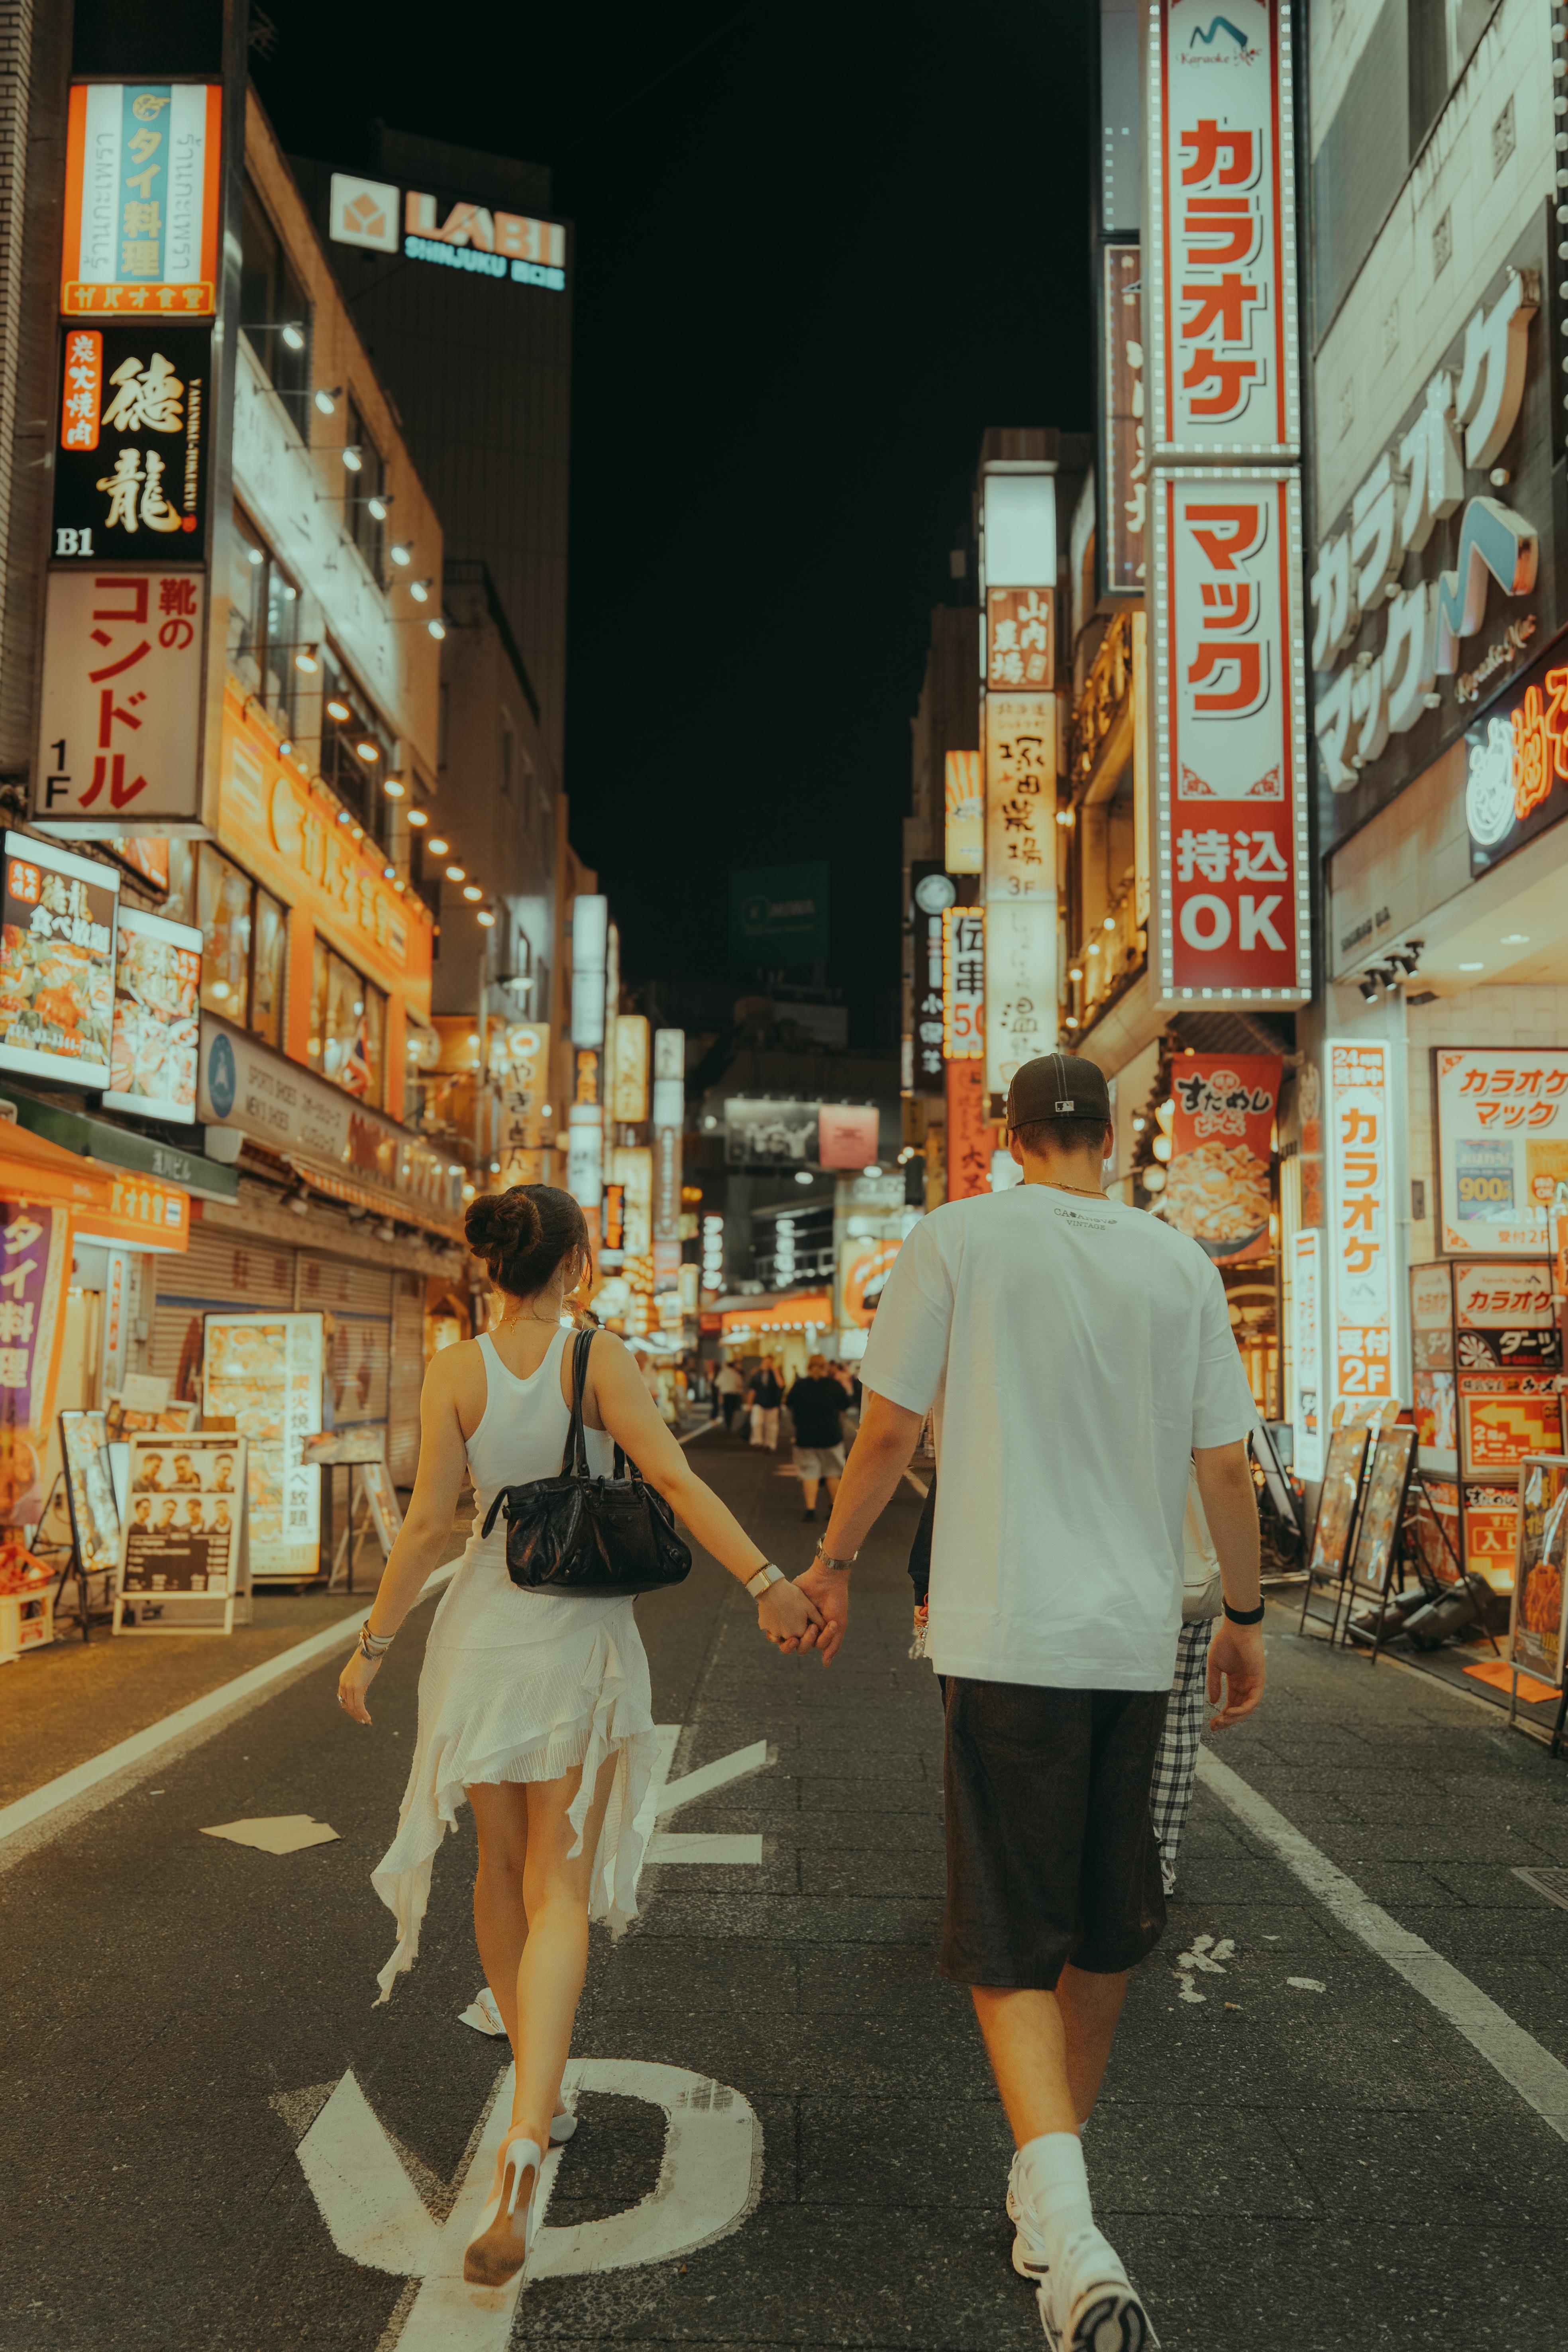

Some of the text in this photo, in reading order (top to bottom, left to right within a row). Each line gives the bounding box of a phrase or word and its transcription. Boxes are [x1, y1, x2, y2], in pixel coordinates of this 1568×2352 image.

[121, 128, 163, 276] タイ料理
[405, 190, 565, 268] LABI
[404, 236, 507, 278] SHINJUKU
[1178, 119, 1262, 418] カラオケ
[75, 287, 204, 309] ガパオ食堂
[66, 334, 96, 446] 炭火焼肉
[1311, 272, 1529, 671] カラオケ
[55, 527, 94, 556] B1
[158, 578, 197, 650] 靴の
[1185, 504, 1262, 711] マック
[77, 577, 152, 809] コンドル
[45, 738, 71, 809] 1F
[1176, 829, 1288, 882] 持込
[1008, 876, 1035, 896] 3F
[1179, 893, 1287, 951] OK
[1460, 1069, 1568, 1094] カラオケ
[1475, 1101, 1554, 1125] マック
[1340, 1108, 1380, 1272] カラオケ
[1458, 1177, 1504, 1202] 900
[1066, 1219, 1106, 1230] VINTAGE
[1338, 1329, 1389, 1356] 受付
[1342, 1358, 1385, 1392] 2F
